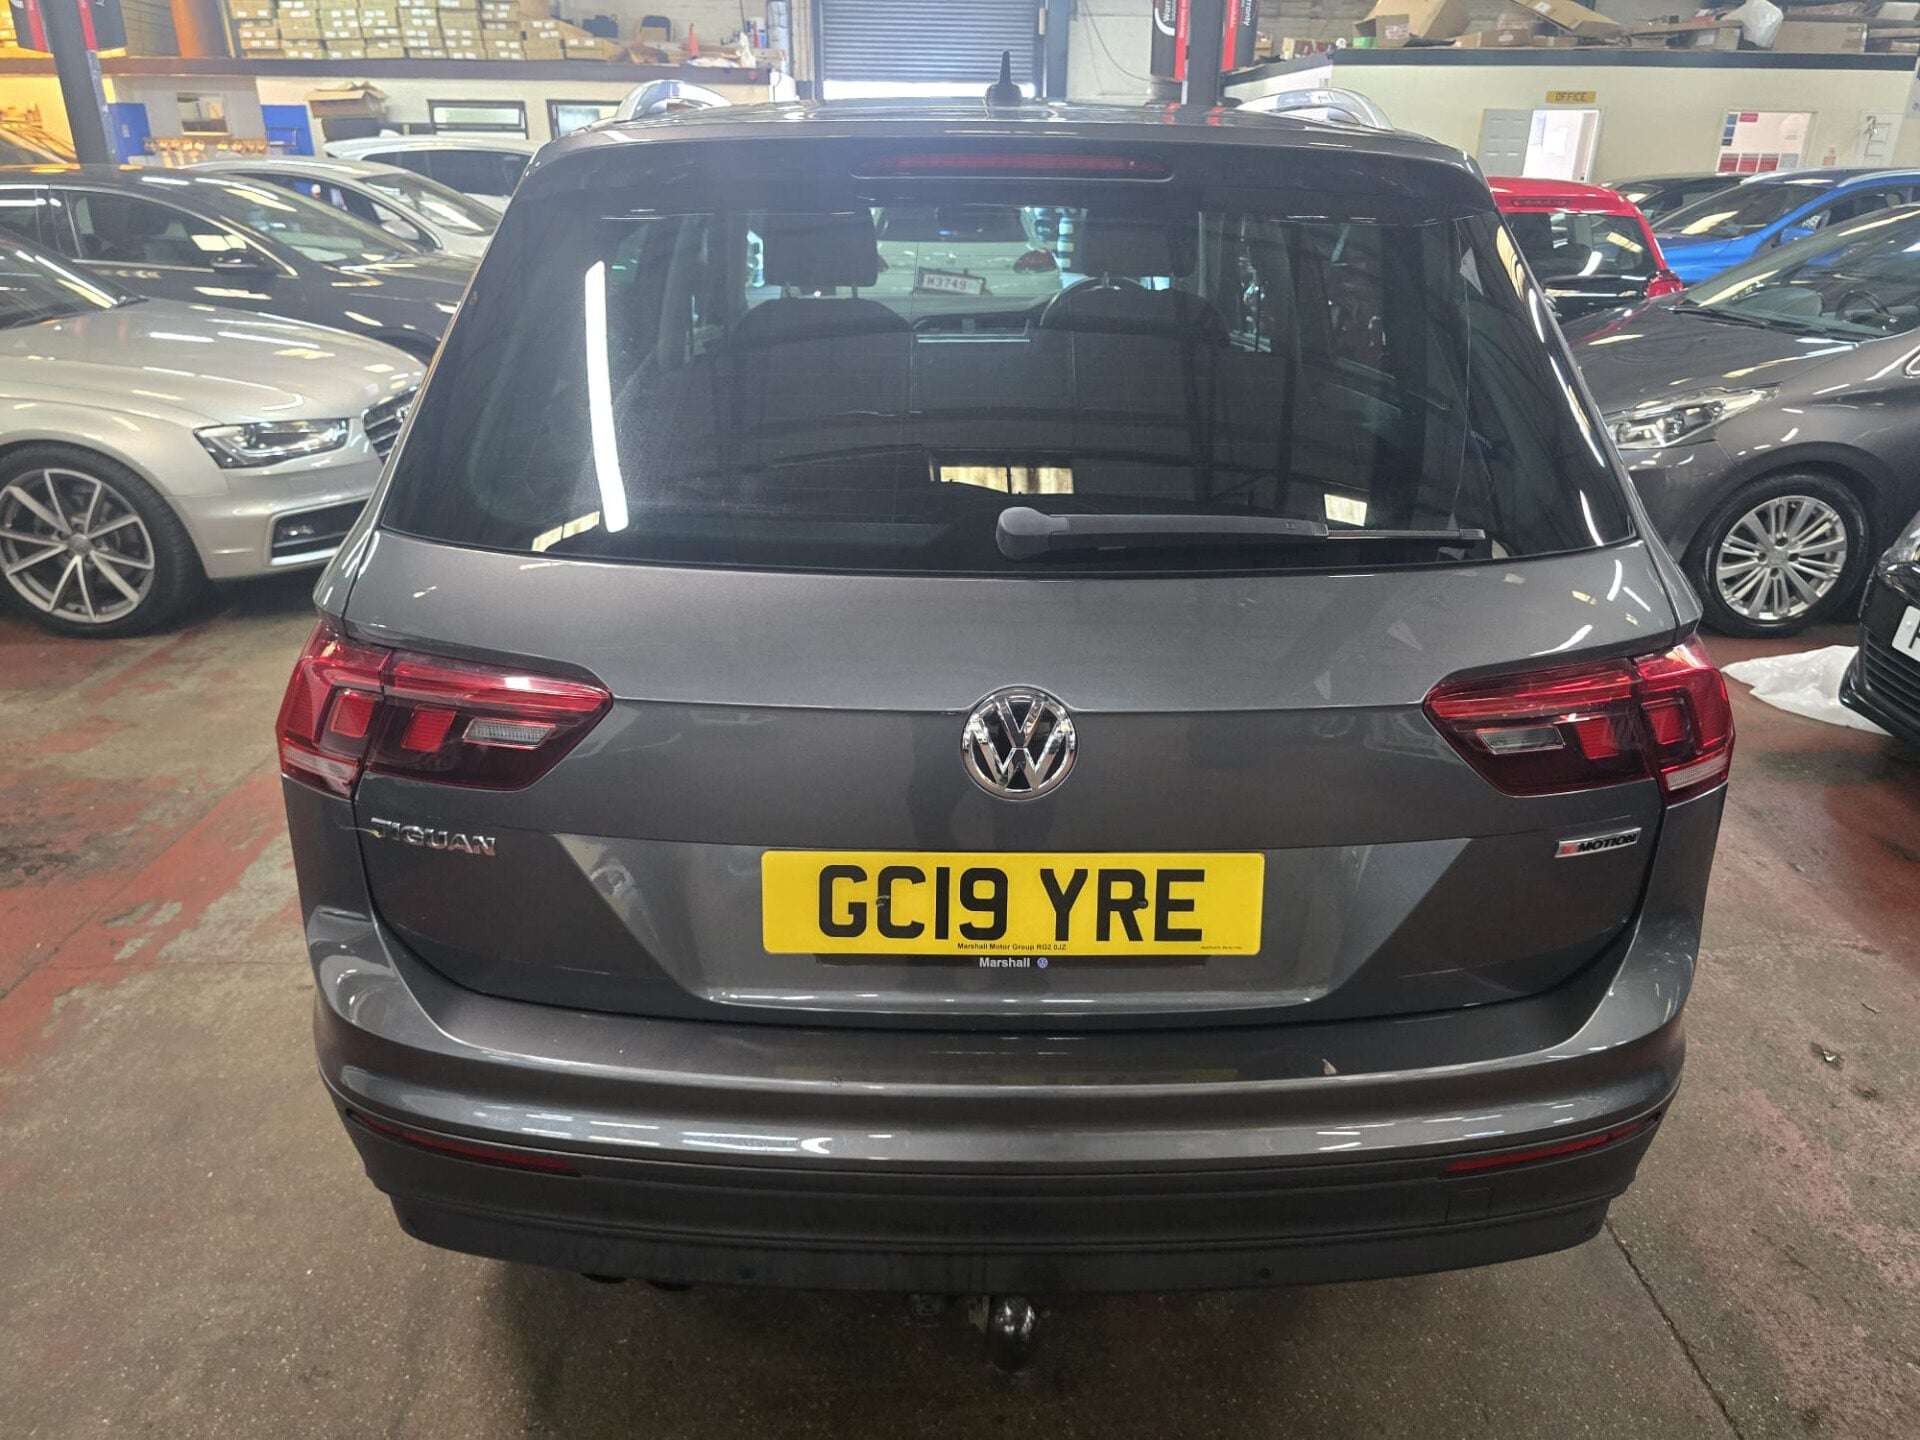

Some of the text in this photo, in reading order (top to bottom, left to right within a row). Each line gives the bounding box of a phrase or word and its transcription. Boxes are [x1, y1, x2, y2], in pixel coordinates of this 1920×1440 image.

[1555, 91, 1588, 102] OFFICE
[818, 864, 1206, 942] GC19 YRE
[1012, 943, 1035, 951] Group
[979, 957, 1030, 968] Marshall
